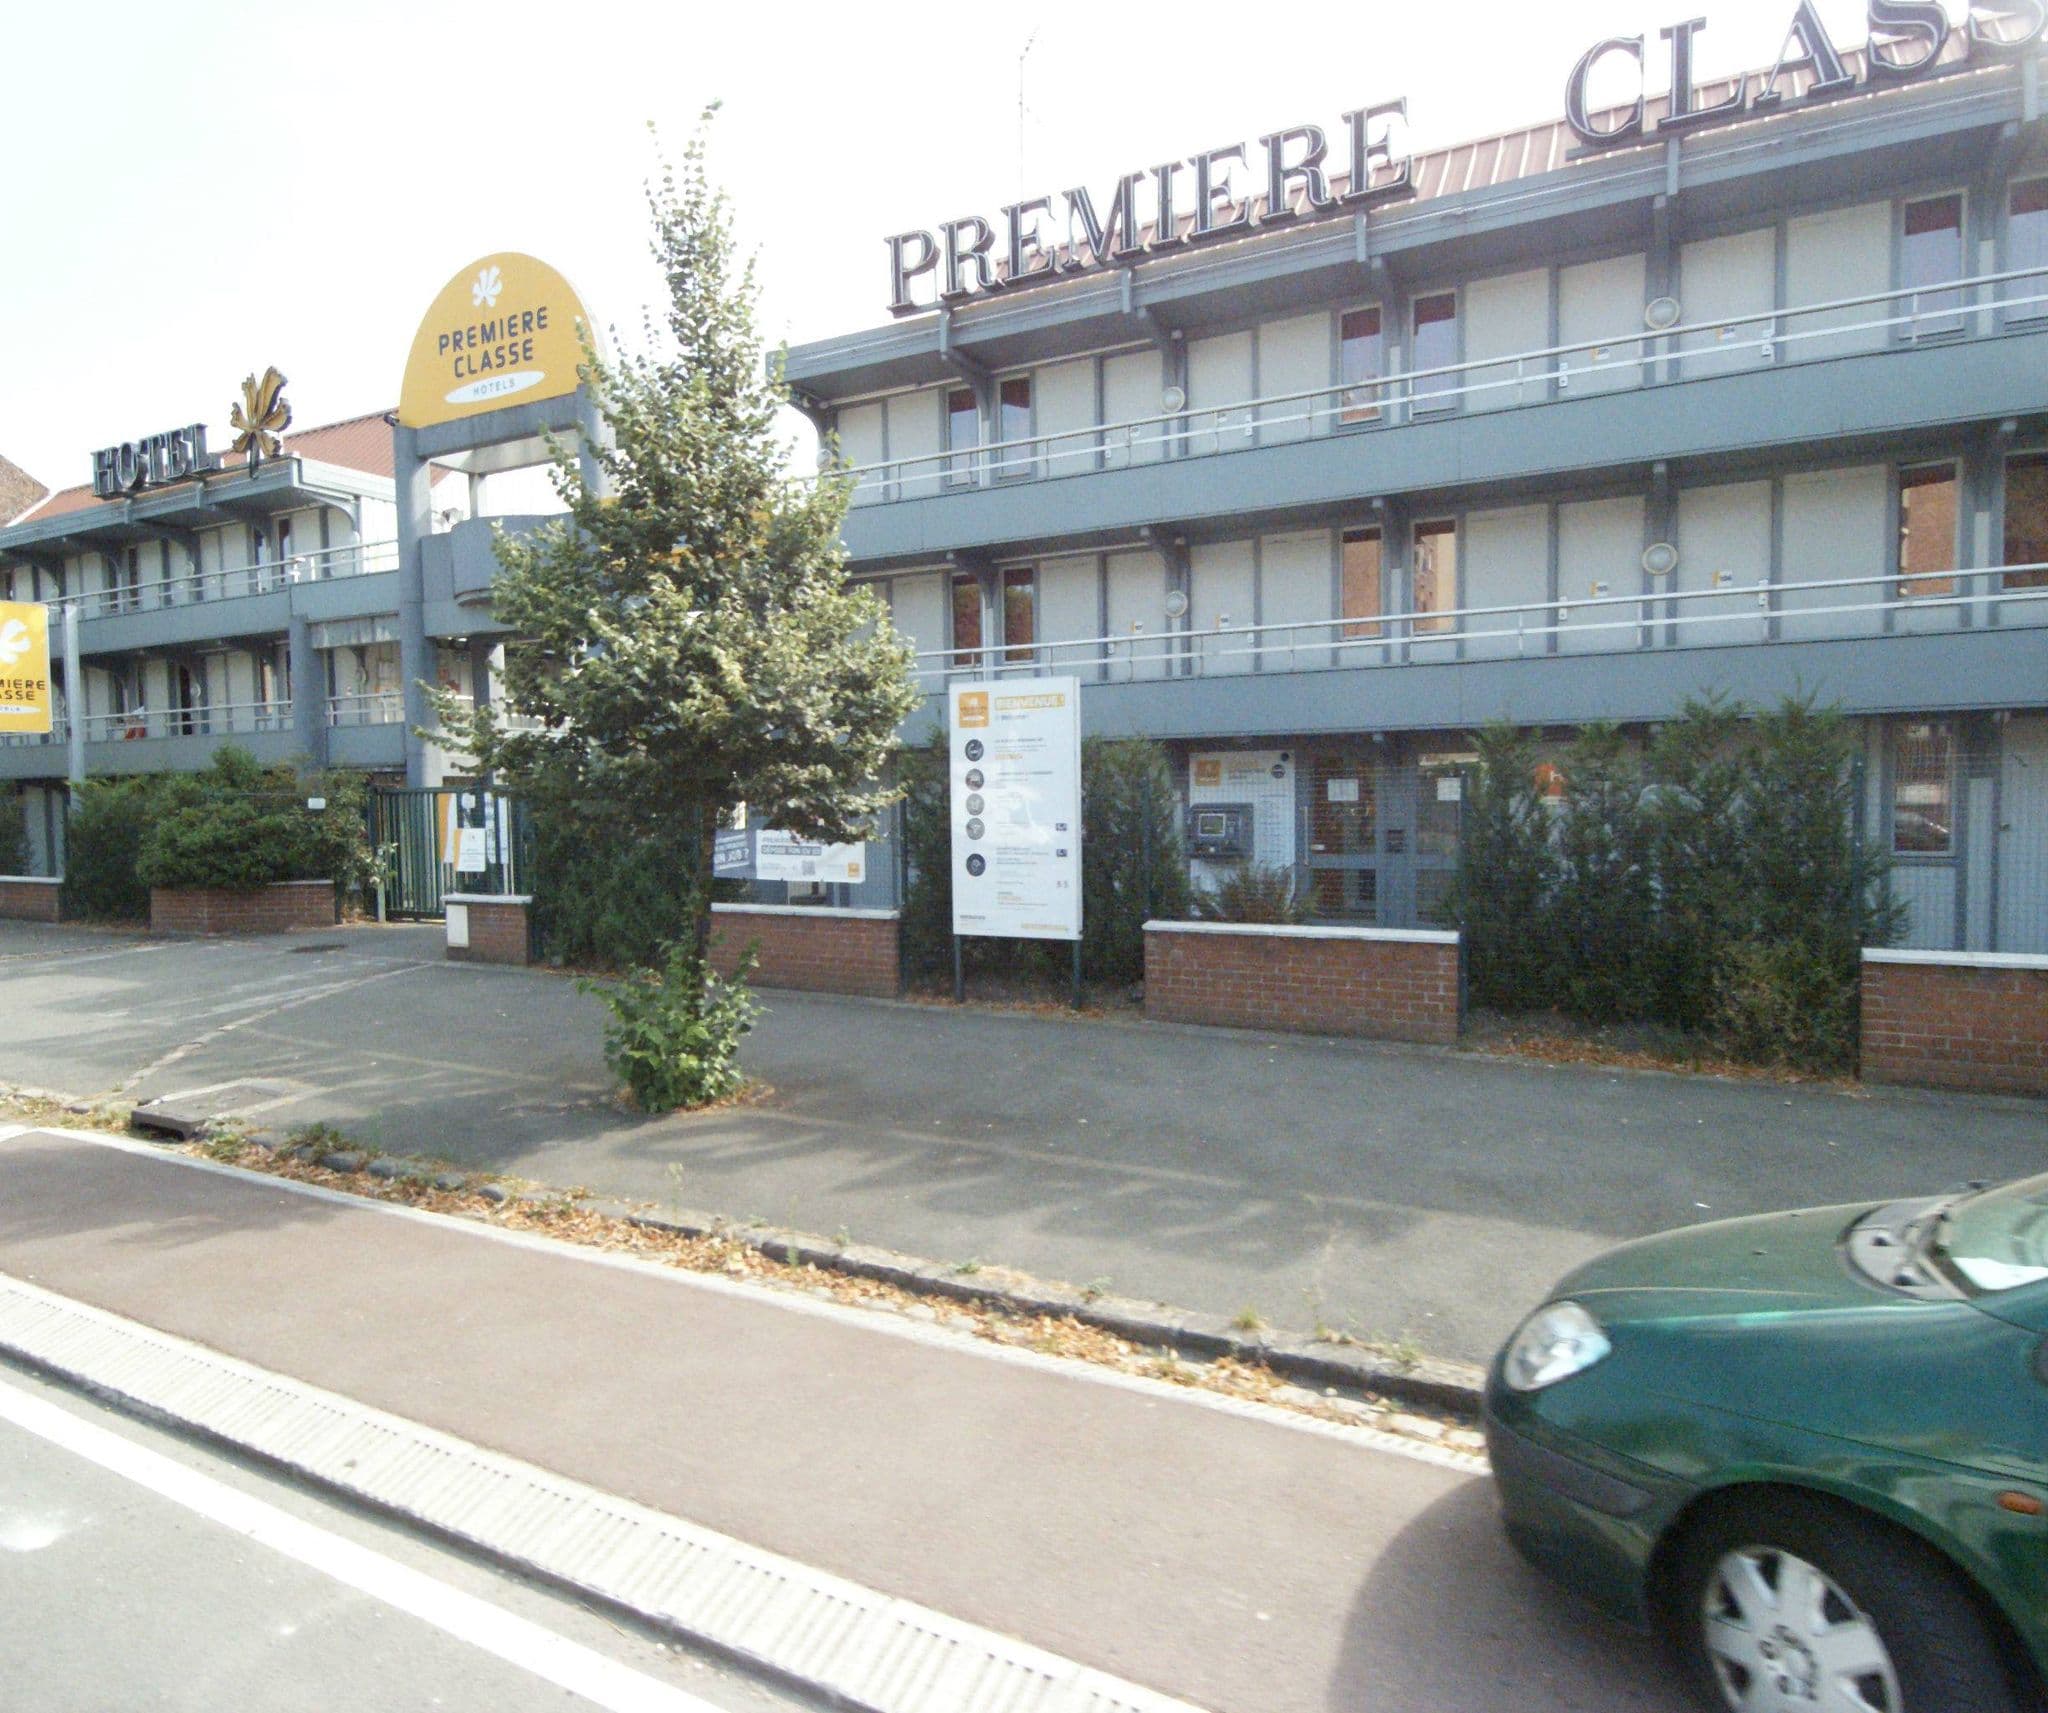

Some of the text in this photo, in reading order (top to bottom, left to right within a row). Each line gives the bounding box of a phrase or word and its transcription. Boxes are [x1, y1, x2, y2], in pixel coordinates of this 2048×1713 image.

[884, 97, 1418, 318] PREMIERE
[438, 306, 548, 356] PREMIERE
[454, 338, 534, 379] CLASSE
[473, 378, 516, 396] HOTELS
[90, 422, 222, 498] HOTEL
[0, 689, 36, 701] SSE
